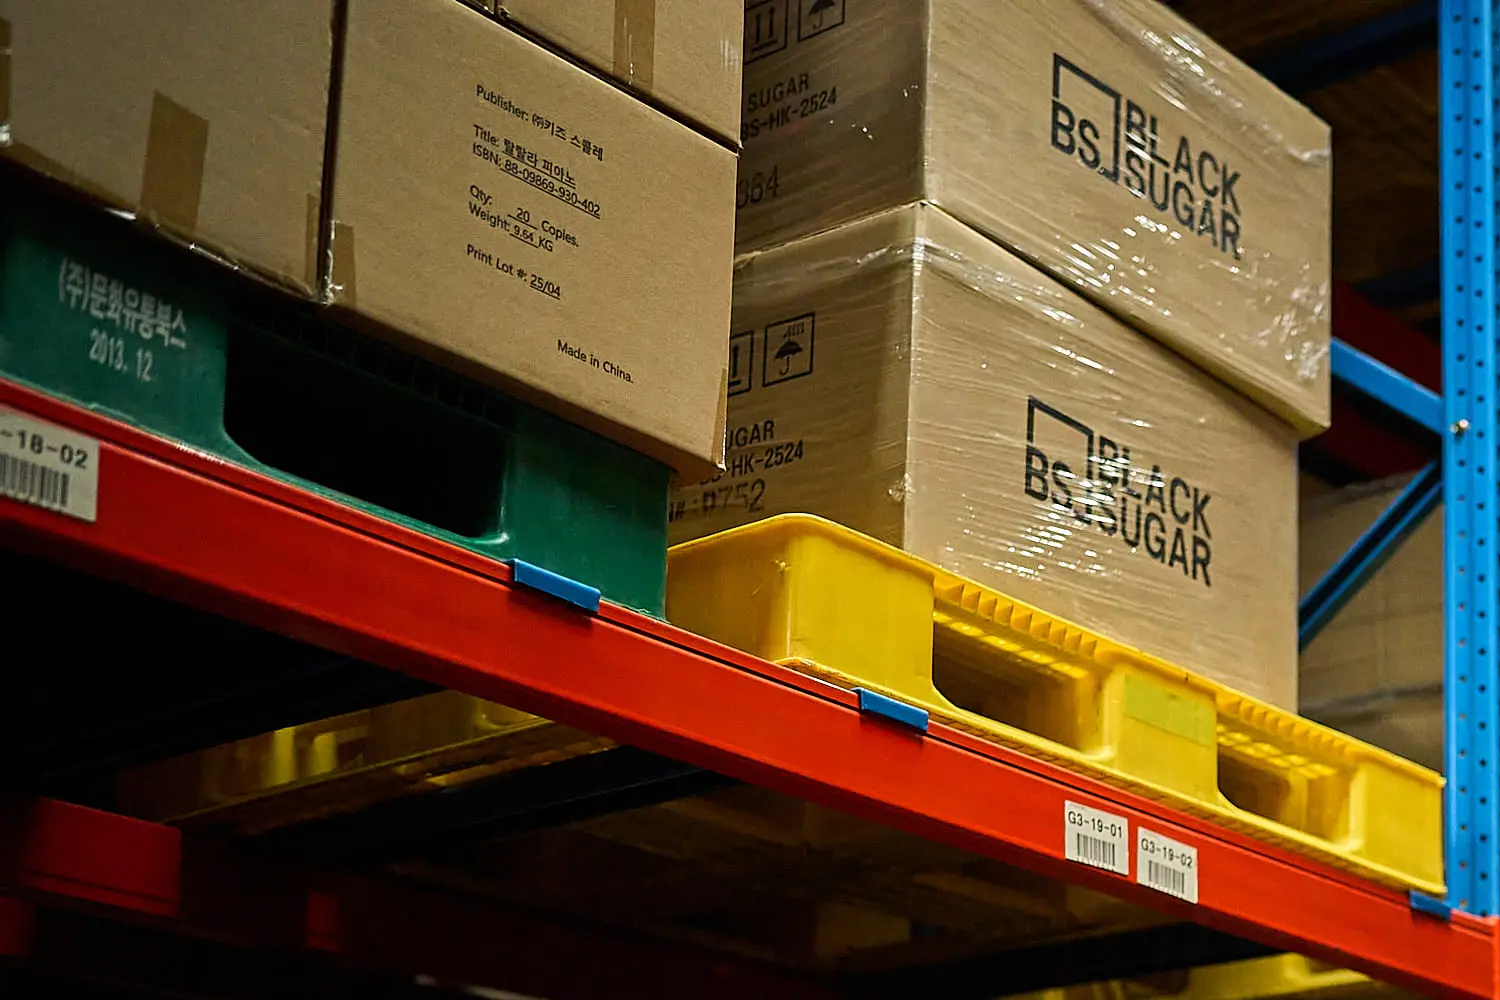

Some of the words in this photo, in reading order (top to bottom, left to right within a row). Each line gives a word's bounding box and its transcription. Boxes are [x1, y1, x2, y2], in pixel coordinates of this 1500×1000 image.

[476, 84, 529, 122] Publisher:
[747, 72, 809, 113] SUGAR
[472, 143, 501, 167] ISBN:
[473, 124, 500, 148] Title:
[1125, 99, 1242, 217] BLACK
[468, 201, 510, 232] Weight:
[538, 235, 553, 252] KG
[469, 184, 492, 205] Qty:
[516, 207, 530, 223] 20
[541, 220, 580, 247] Copies.
[1124, 149, 1242, 260] SUGAR
[466, 244, 492, 266] Print
[496, 258, 513, 276] Lot
[530, 274, 561, 297] 25/04
[136, 347, 153, 382] 12
[557, 339, 587, 362] Made
[590, 354, 600, 368] in
[602, 361, 634, 384] China.
[1098, 434, 1212, 540] BLACK
[1098, 486, 1212, 588] SUGAR
[1068, 811, 1122, 838] G3-19-01
[1141, 838, 1193, 870] G3-19-02
